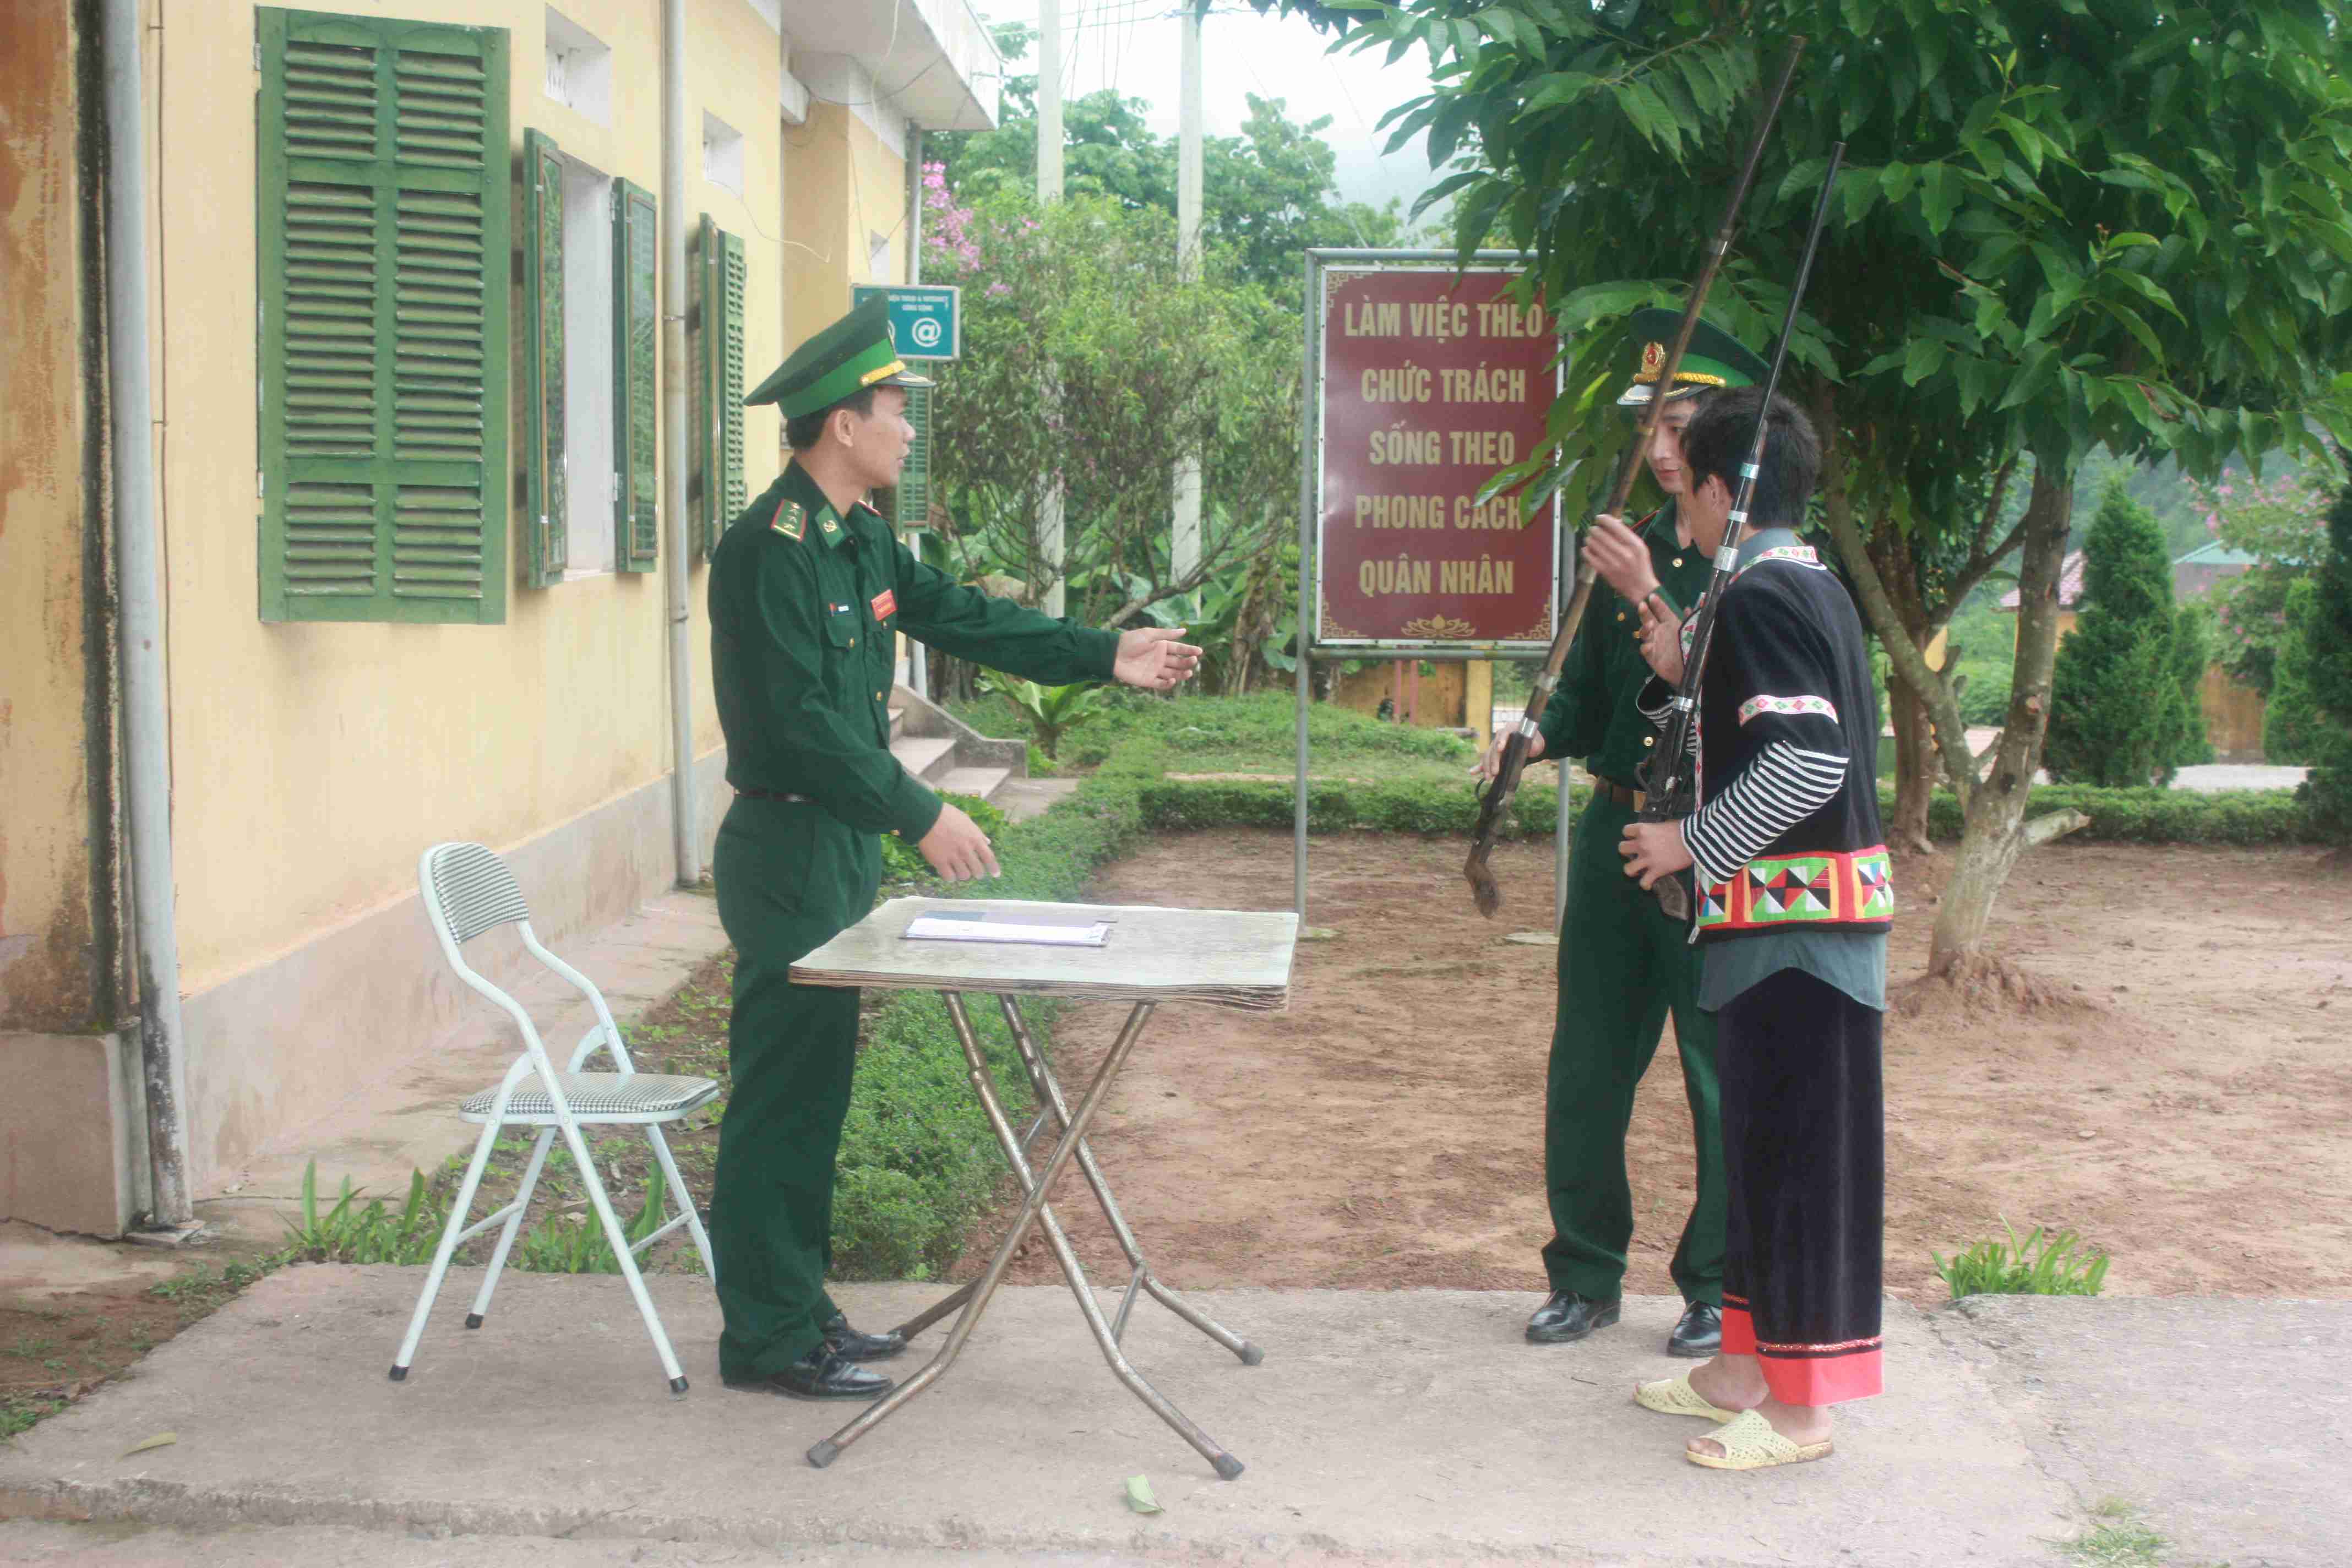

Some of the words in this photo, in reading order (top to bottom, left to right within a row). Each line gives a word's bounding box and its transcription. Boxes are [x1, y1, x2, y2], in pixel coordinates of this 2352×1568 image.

[1344, 295, 1401, 336] LÀM
[1409, 295, 1468, 344] VIỆC
[1477, 303, 1543, 337] THEO
[1361, 360, 1431, 402] CHỨC
[1440, 362, 1526, 402] TRÁCH
[1369, 420, 1441, 465] SỐNG
[1449, 431, 1515, 465] THEO
[1355, 495, 1445, 529] PHONG
[1359, 553, 1431, 597] QUÂN
[1440, 554, 1515, 594] NHÂN
